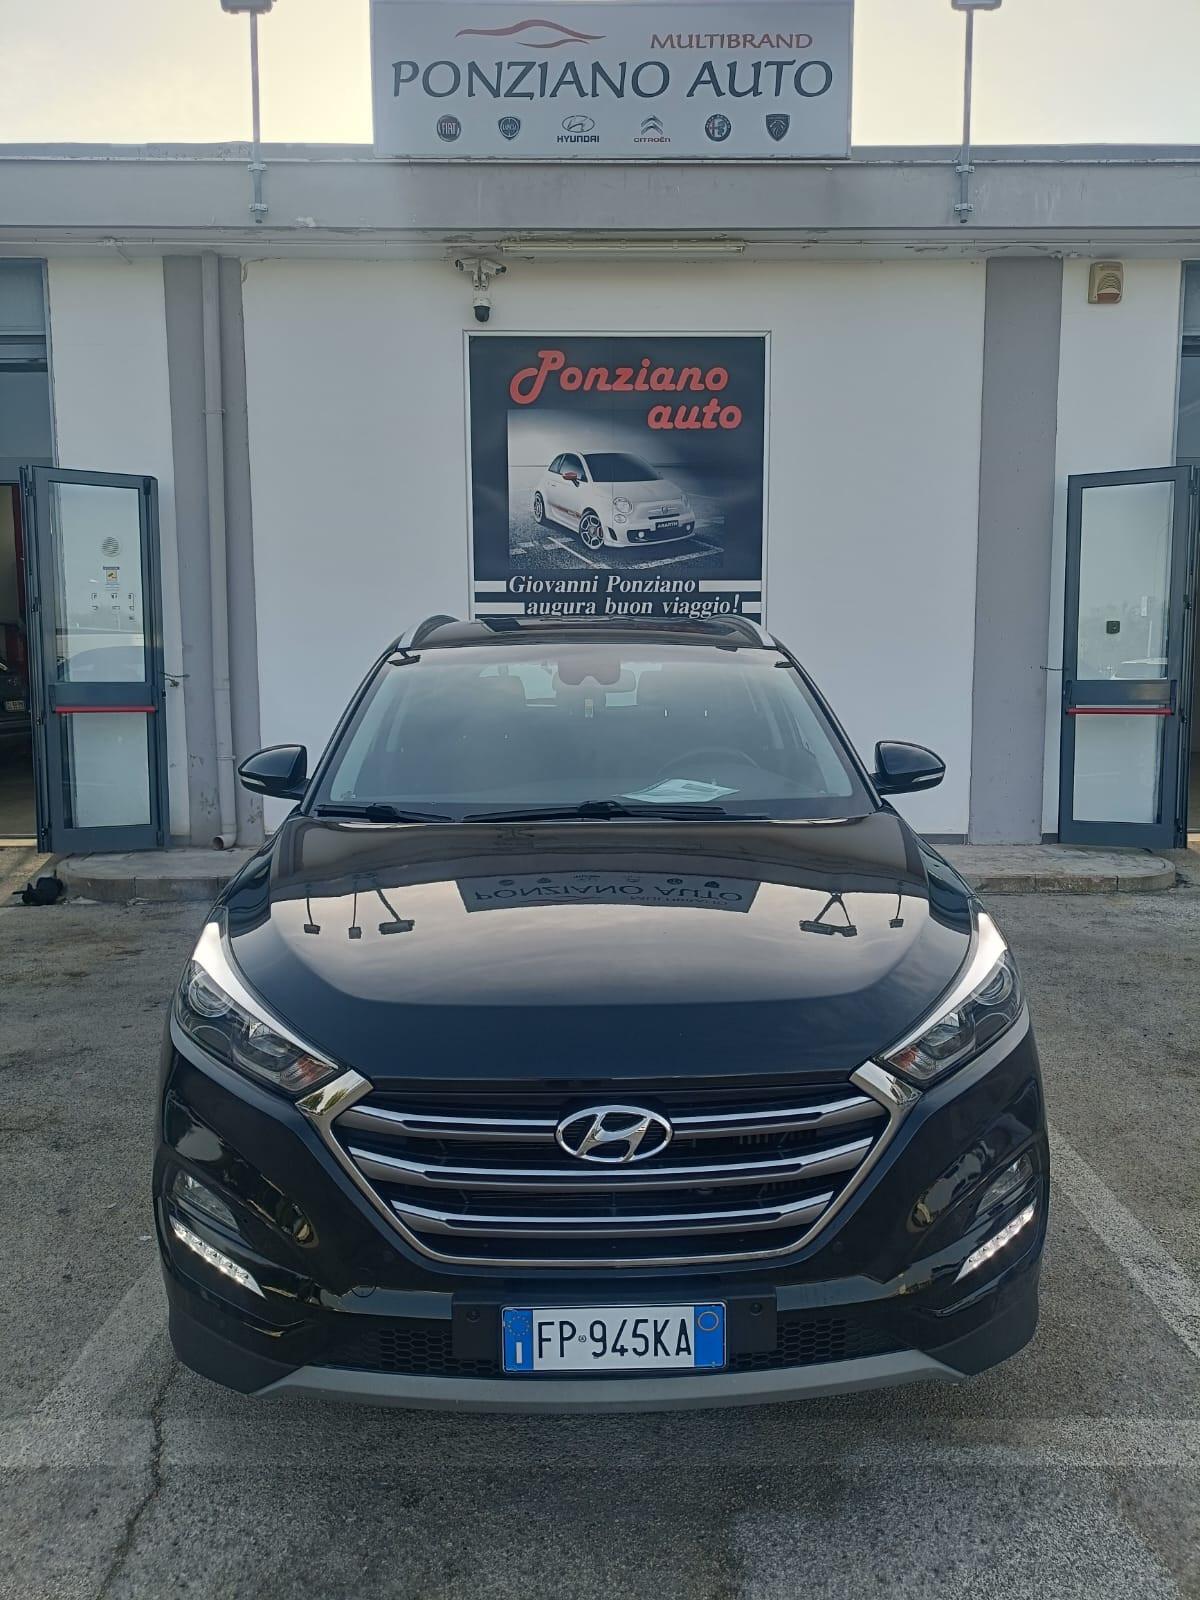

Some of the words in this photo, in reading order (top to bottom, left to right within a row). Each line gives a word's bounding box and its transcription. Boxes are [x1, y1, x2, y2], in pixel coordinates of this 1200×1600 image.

[650, 33, 813, 49] MULTIBRAND
[391, 60, 670, 100] PONZIANO
[686, 60, 833, 98] AUTO
[441, 122, 456, 135] FIAT
[556, 135, 600, 143] HYUNDAI
[509, 349, 729, 405] Ponziano
[647, 398, 742, 430] auto
[508, 575, 599, 593] Giovanni
[606, 576, 696, 594] Ponziano
[527, 601, 596, 616] augura
[605, 597, 653, 614] buon
[662, 594, 741, 619] viaggio!
